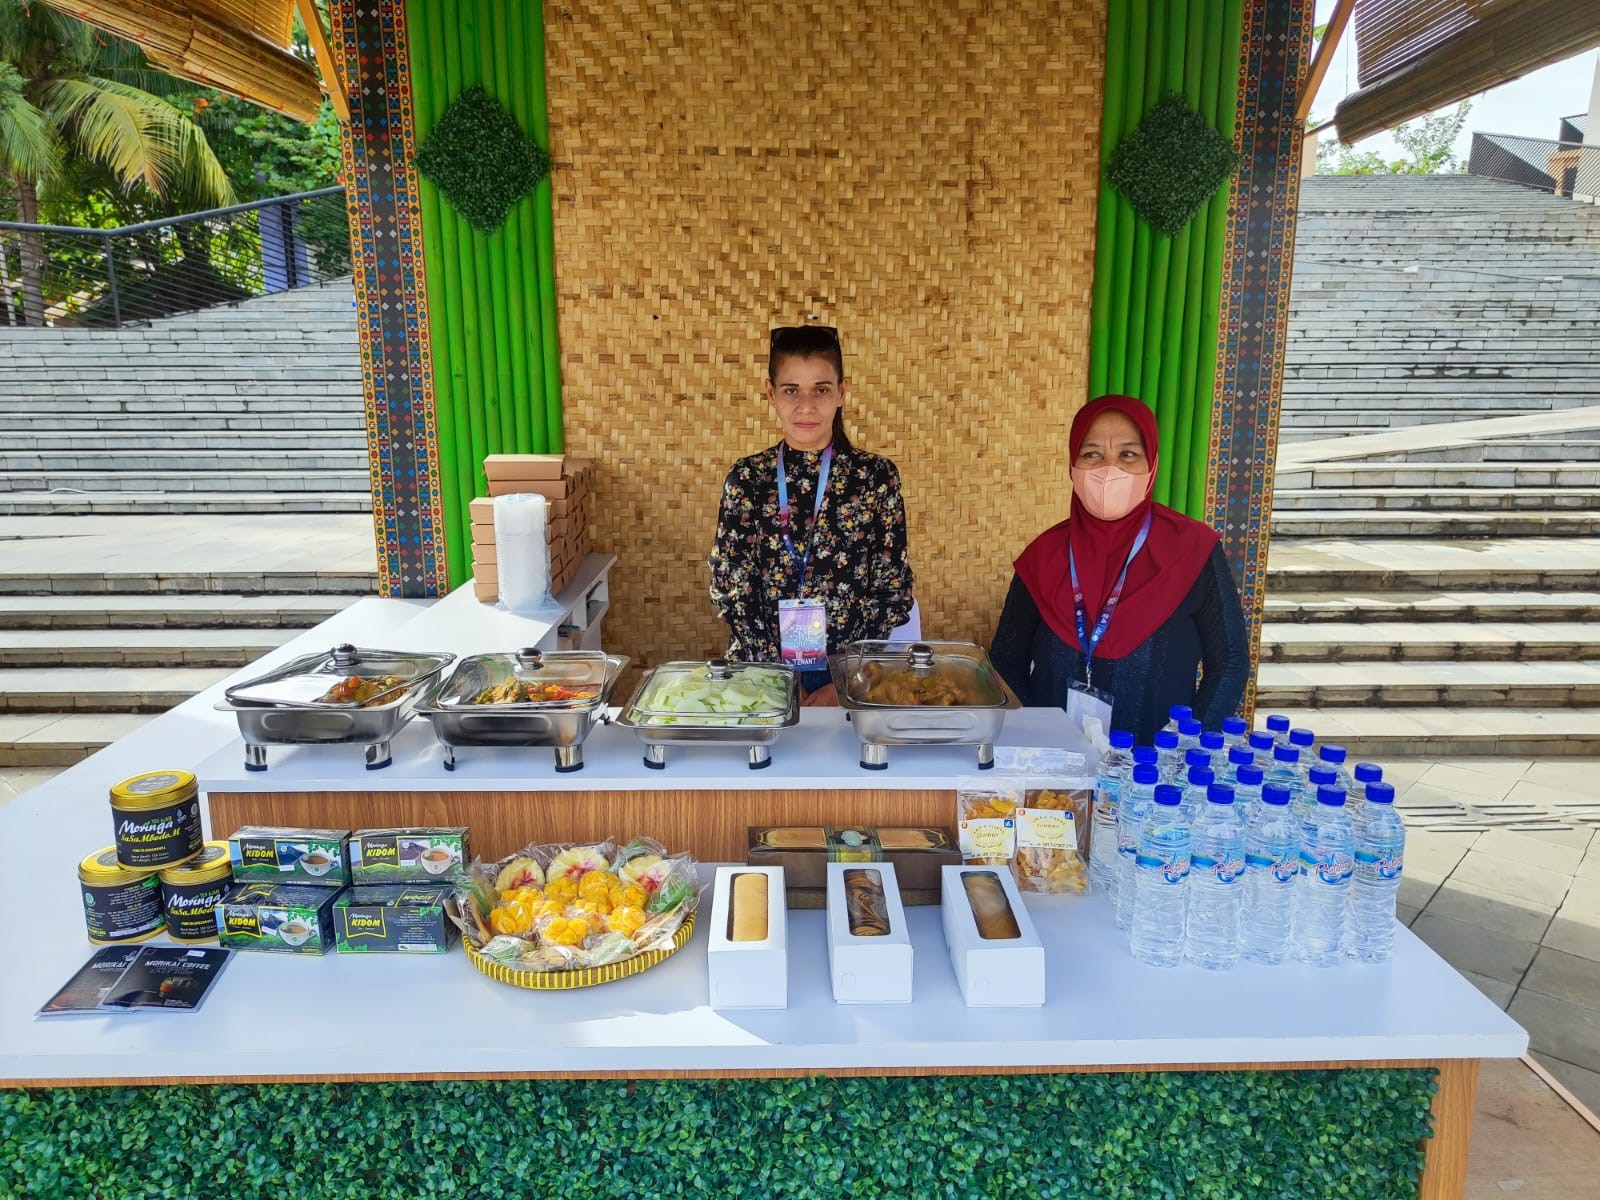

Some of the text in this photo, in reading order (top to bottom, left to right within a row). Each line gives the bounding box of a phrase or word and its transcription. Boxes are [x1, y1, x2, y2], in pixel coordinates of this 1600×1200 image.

[792, 657, 817, 666] TENANT
[118, 819, 174, 836] Moringa
[245, 849, 274, 858] KIDOM
[366, 848, 396, 857] KIDOM
[167, 892, 221, 908] Moringa
[228, 917, 256, 926] KIDOM
[351, 919, 381, 927] KIDOM
[144, 960, 211, 970] MORIKAI COFFEE
